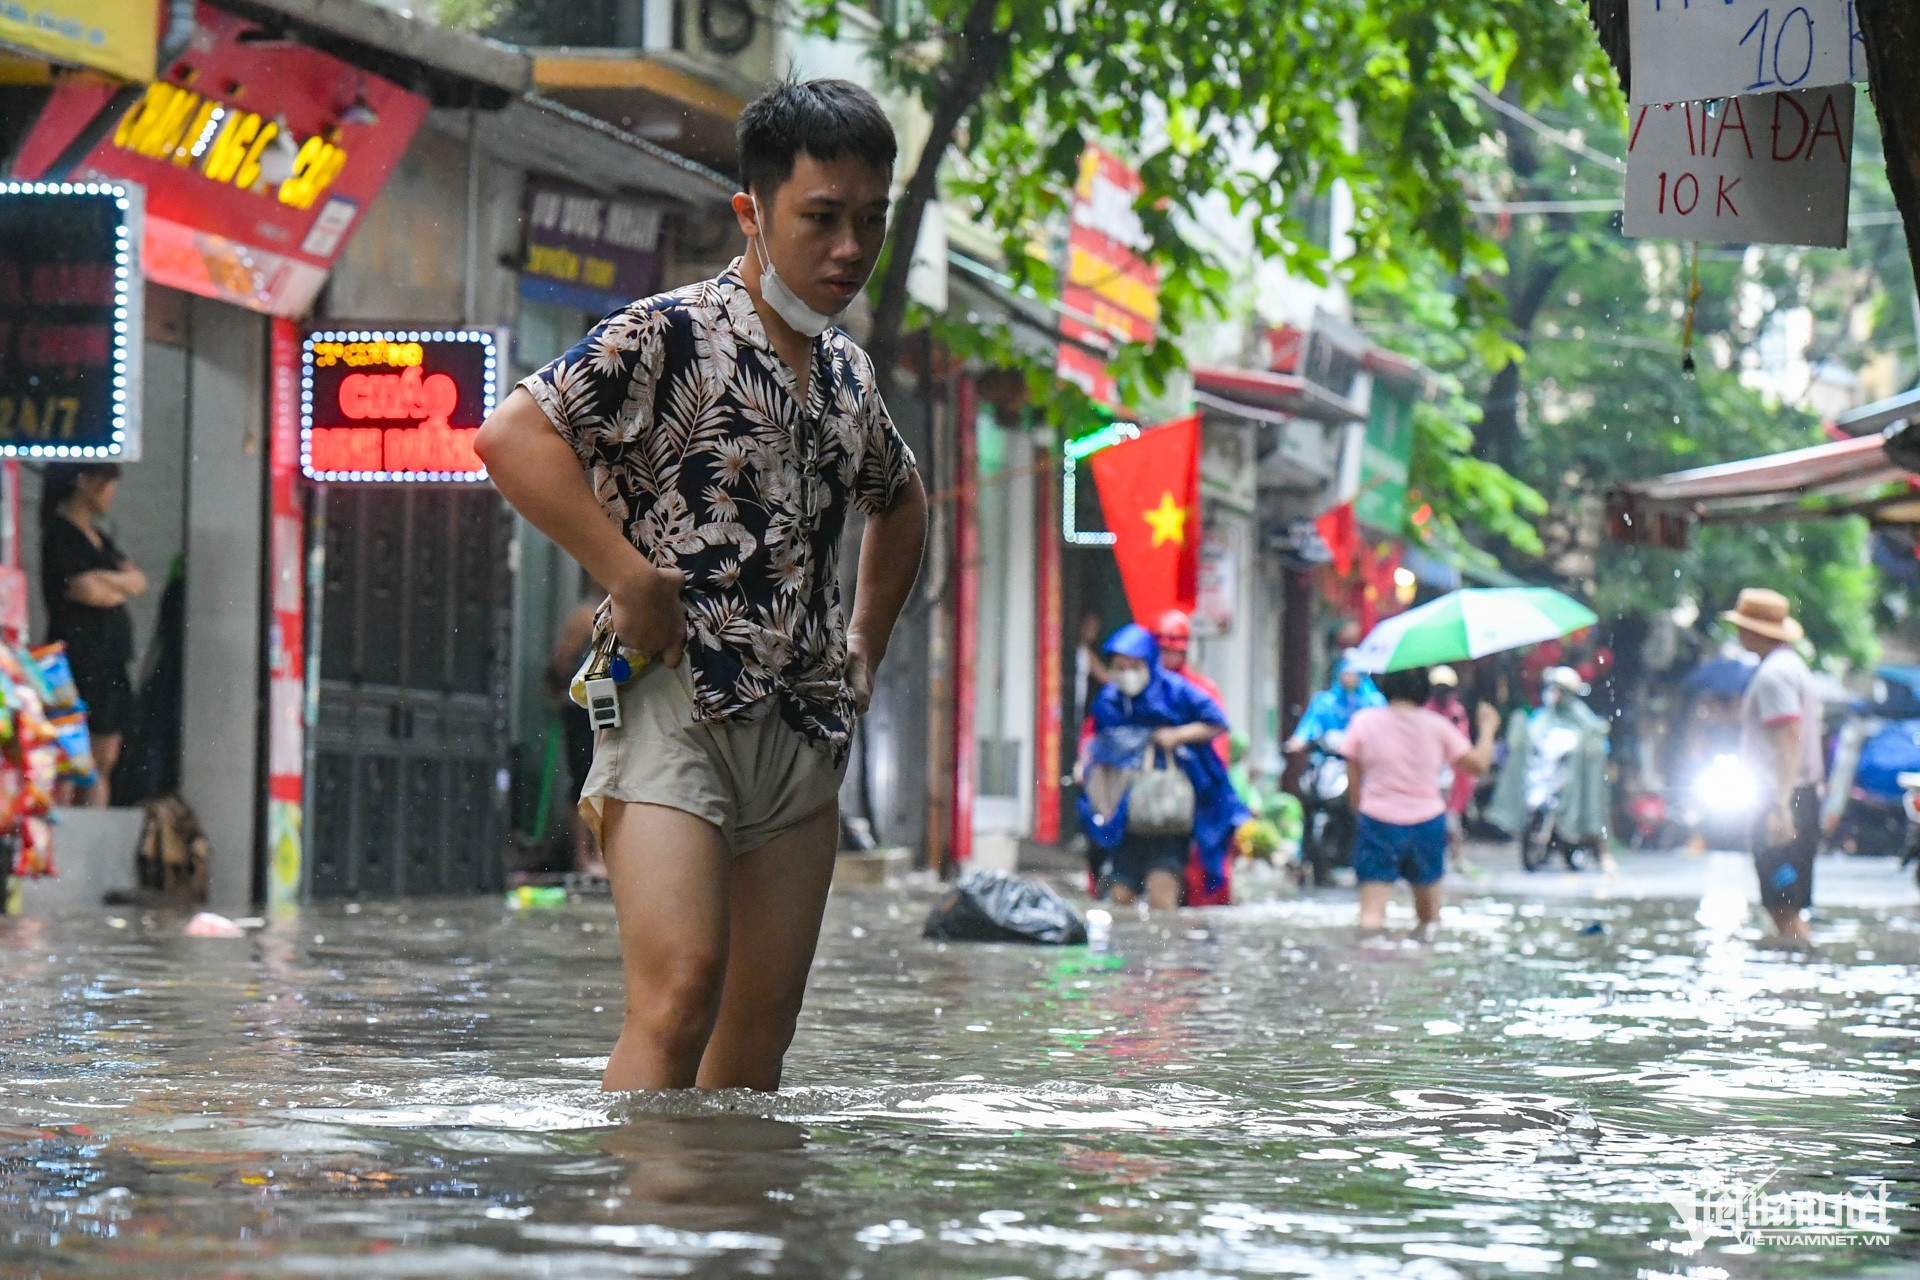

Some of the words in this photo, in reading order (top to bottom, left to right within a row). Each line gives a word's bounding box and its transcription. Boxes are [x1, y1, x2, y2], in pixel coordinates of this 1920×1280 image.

[1739, 7, 1814, 91] 10
[1657, 171, 1699, 216] 10
[1716, 174, 1741, 217] K
